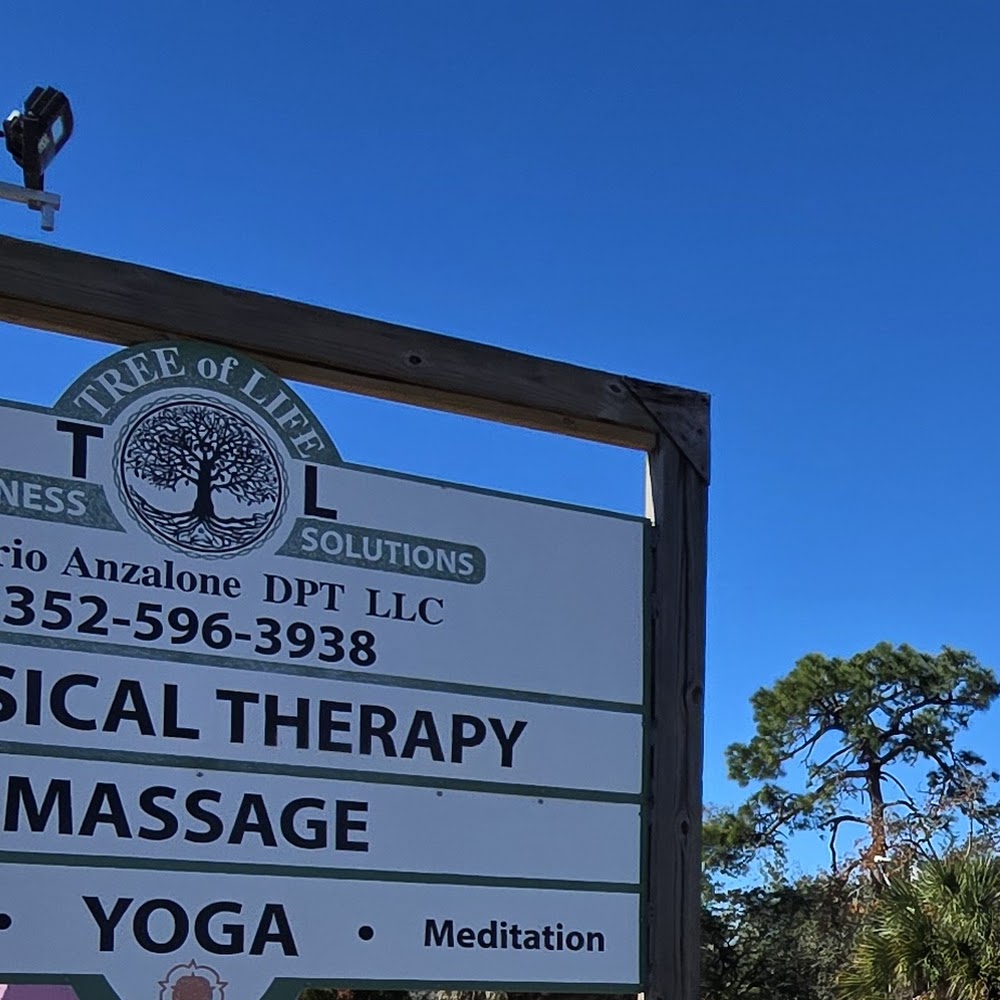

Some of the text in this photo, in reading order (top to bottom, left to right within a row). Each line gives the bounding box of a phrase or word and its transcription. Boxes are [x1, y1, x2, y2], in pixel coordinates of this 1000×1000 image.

[74, 347, 325, 459] TREE of LIFE
[56, 420, 338, 520] T L
[0, 478, 474, 576] NESS SOLUTIONS
[3, 585, 377, 667] 352-596-3938
[61, 546, 241, 598] Anzalone
[262, 573, 345, 612] DPT
[365, 587, 444, 626] LLC
[216, 689, 528, 768] THERAPY
[3, 775, 370, 853] MASSAGE
[82, 896, 606, 957] YOGA Meditation
